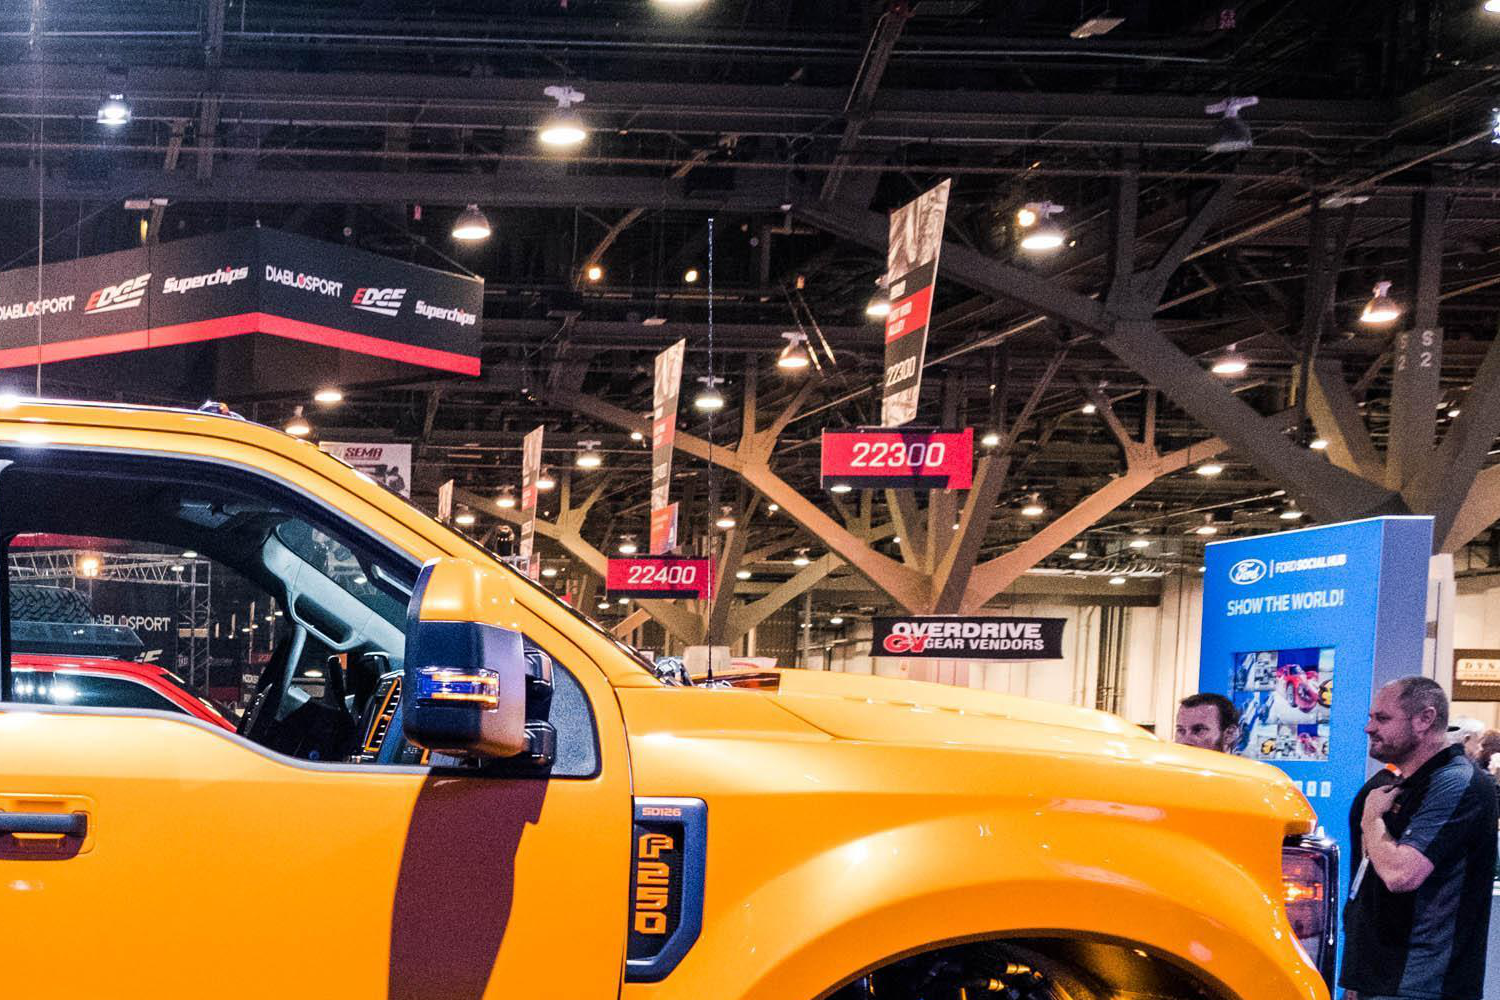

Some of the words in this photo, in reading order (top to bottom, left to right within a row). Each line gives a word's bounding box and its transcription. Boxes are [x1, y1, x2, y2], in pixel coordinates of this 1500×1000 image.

[85, 273, 153, 311] EDGE
[162, 266, 249, 294] Superchips
[265, 264, 343, 298] DIABLOSPORT
[352, 287, 407, 308] EDGE
[414, 300, 477, 326] Superchips
[344, 447, 383, 460] SEMA
[850, 442, 945, 467] 22300
[628, 565, 696, 584] 22400
[1227, 597, 1263, 617] SHOW
[1265, 594, 1290, 613] THE
[1292, 589, 1345, 610] WORLD!
[892, 622, 1042, 639] OVERDRIVE
[926, 638, 965, 650] GEAR
[969, 639, 1044, 650] VENDORS
[642, 807, 682, 817] SD126
